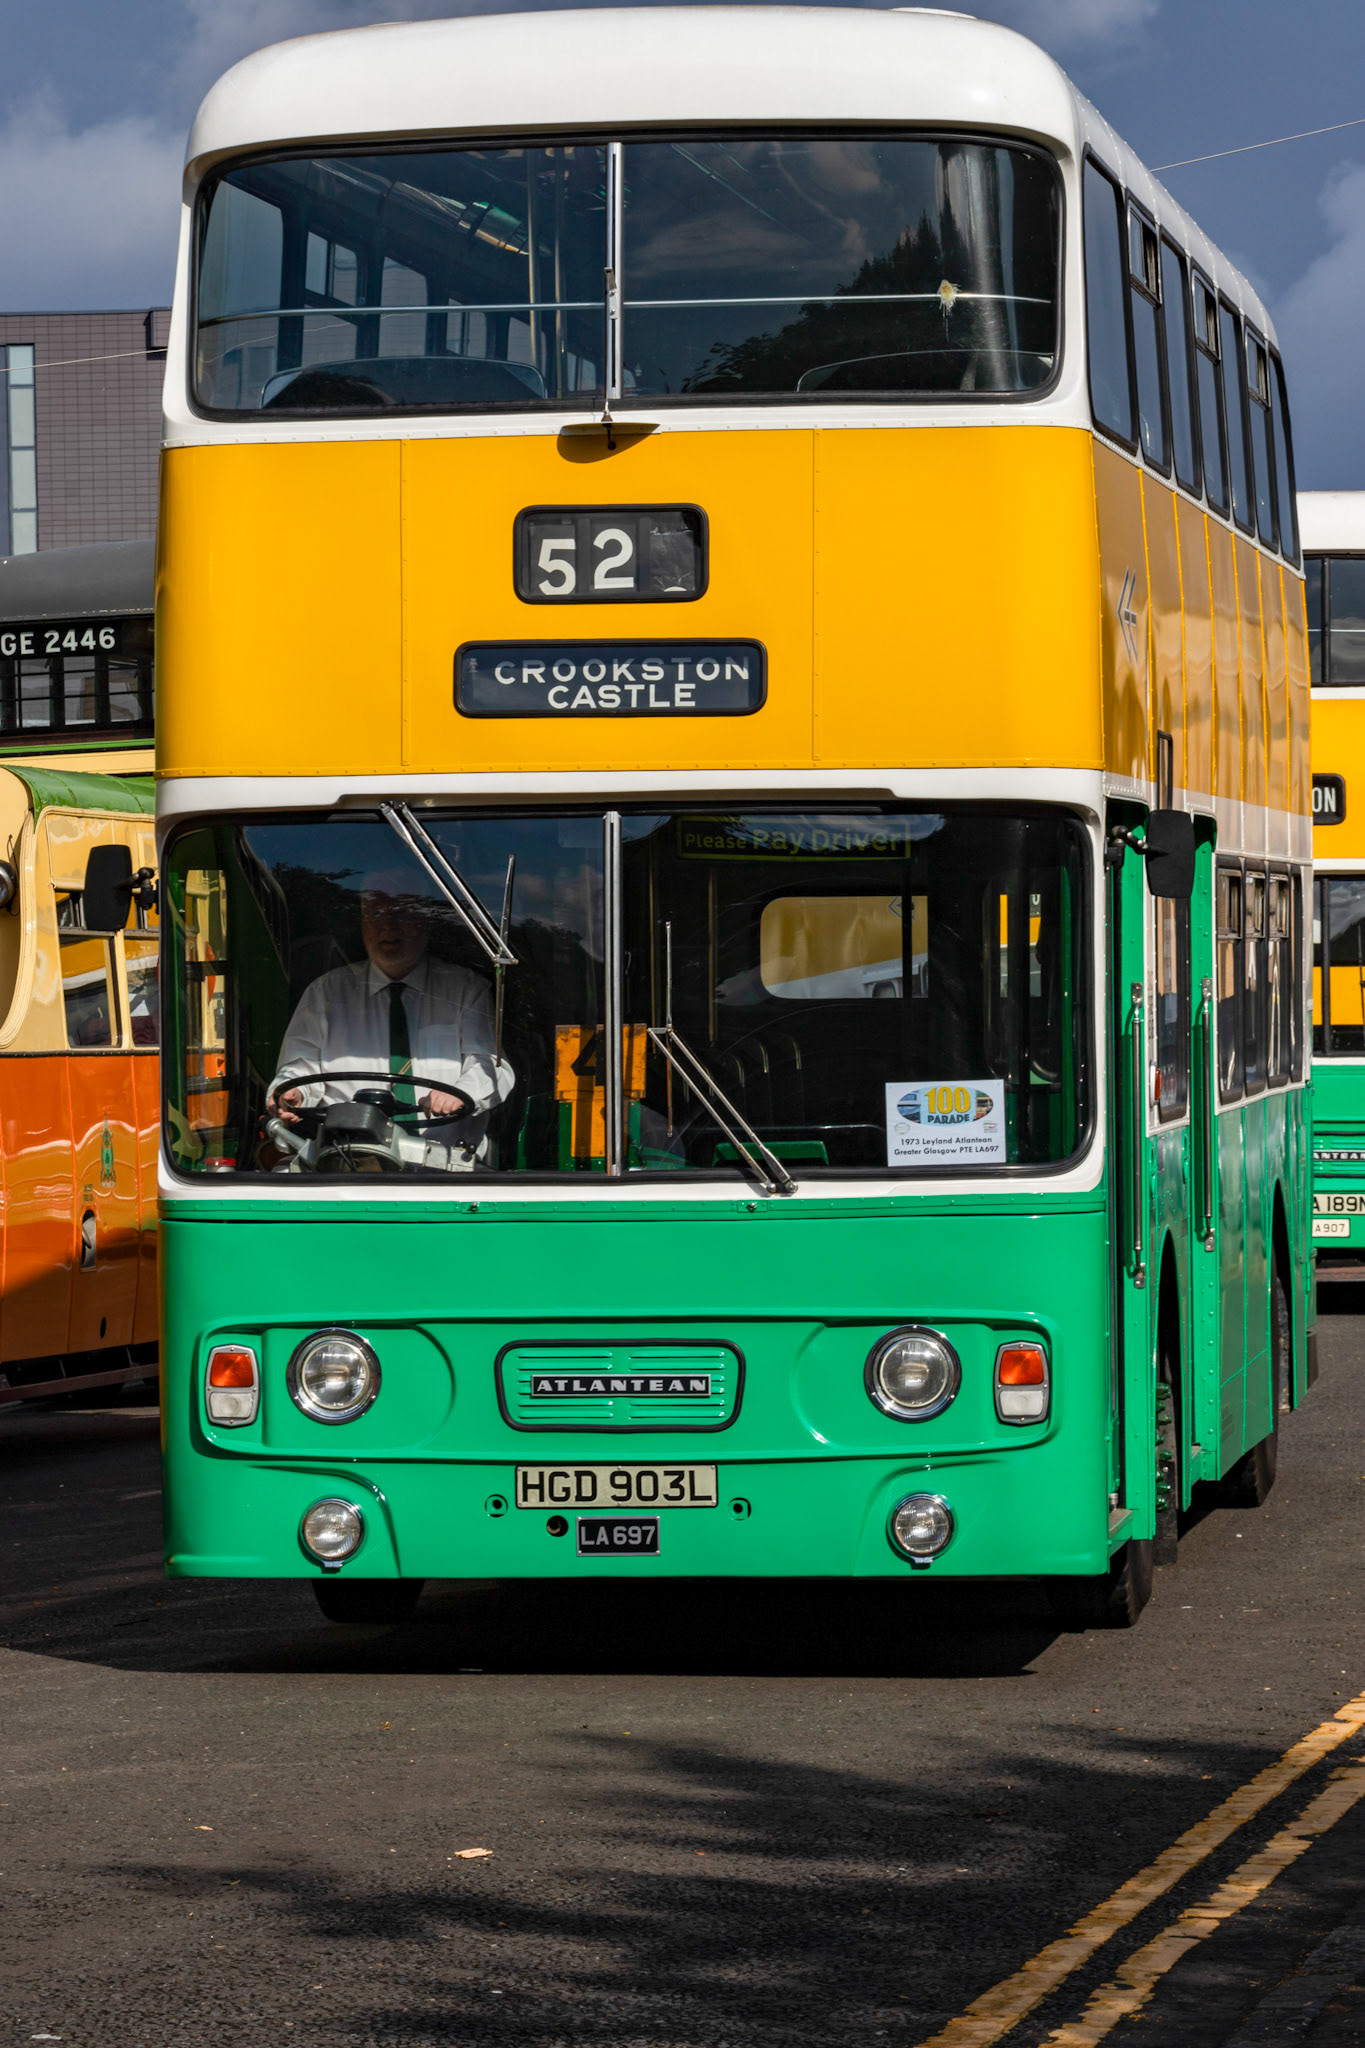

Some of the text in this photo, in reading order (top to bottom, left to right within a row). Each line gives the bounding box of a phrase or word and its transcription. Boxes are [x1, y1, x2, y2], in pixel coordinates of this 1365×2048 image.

[1, 627, 115, 656] GE 2446
[494, 656, 749, 684] CROOKSTON
[548, 683, 696, 709] CASTLE
[685, 829, 902, 854] Please Pay Driver
[924, 1086, 971, 1114] 100
[927, 1114, 970, 1124] PARADE
[901, 1138, 920, 1146] 1973
[922, 1137, 952, 1146] Leyland
[923, 1147, 957, 1155] Glasgow
[975, 1145, 999, 1153] LA697
[537, 1379, 706, 1392] ATLANTEAN
[522, 1470, 712, 1502] HGD 903L
